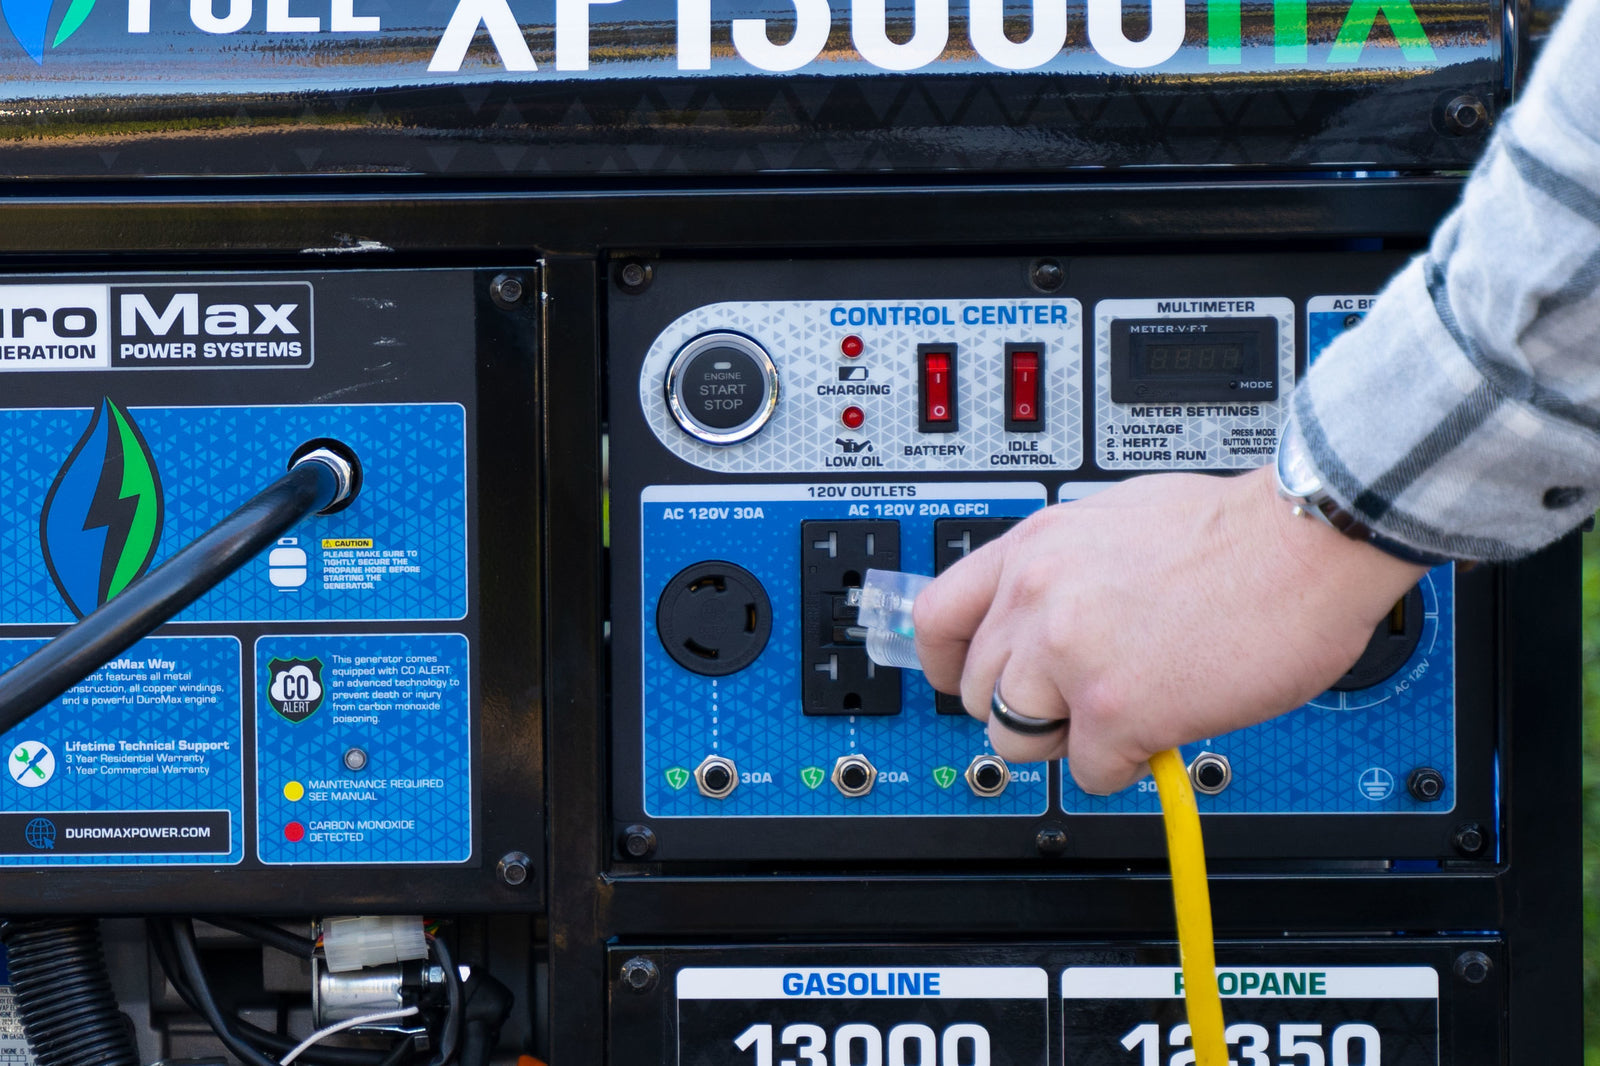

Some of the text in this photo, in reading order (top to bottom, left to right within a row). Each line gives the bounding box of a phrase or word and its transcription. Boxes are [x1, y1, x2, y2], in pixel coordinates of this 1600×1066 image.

[1157, 301, 1255, 313] MULTIMETER
[1333, 299, 1353, 309] AC
[0, 293, 300, 338] ro Max
[830, 305, 1068, 326] CONTROL CENTER
[0, 345, 96, 360] ERATION
[121, 341, 302, 359] POWER SYSTEMS
[704, 372, 742, 381] ENGINE
[700, 384, 747, 395] START
[817, 385, 890, 396] CHARGING
[704, 399, 743, 410] STOP
[1131, 406, 1260, 417] METER SETTINGS
[1107, 425, 1183, 435] 1. VOLTAGE
[1008, 441, 1038, 452] IDLE
[1107, 438, 1168, 448] 2. HERTZ
[1223, 438, 1250, 446] BUTTON
[904, 445, 966, 456] BATTERY
[1107, 451, 1206, 461] 3. HOURS RUN
[825, 456, 883, 467] LOW OIL
[990, 454, 1057, 465] CONTROL
[808, 486, 917, 497] 120V OUTLETS
[663, 508, 764, 519] AC 120V 30A
[848, 503, 989, 516] AC 120V 20A GFCI
[323, 582, 375, 590] GENERATOR.
[101, 659, 175, 671] roMax Way
[332, 655, 351, 663] This
[355, 656, 402, 665] generator
[105, 672, 147, 681] features
[150, 672, 161, 681] all
[163, 671, 191, 680] metal
[332, 667, 375, 676] equipped
[378, 667, 398, 675] with
[401, 666, 415, 674] CO
[1395, 658, 1430, 695] AC 120V
[283, 675, 309, 700] CO
[347, 678, 392, 686] advanced
[394, 678, 447, 688] technology
[130, 684, 140, 693] all
[143, 685, 177, 695] copper
[179, 683, 224, 694] windings,
[62, 696, 80, 704] and
[91, 695, 133, 706] powerful
[137, 695, 182, 704] DuroMax
[333, 691, 369, 700] prevent
[372, 690, 399, 698] death
[415, 690, 441, 700] injury
[282, 702, 310, 713] ALERT
[332, 702, 440, 710] from carbon monoxide
[333, 714, 380, 724] poisoning.
[65, 740, 229, 752] Lifetime Technical Support
[66, 754, 204, 764] 3 Year Residential Warranty
[66, 765, 209, 775] 1 Year Commercial Warranty
[741, 772, 773, 784] 30A
[878, 772, 909, 783] 20A
[1010, 771, 1041, 782] 20A
[308, 779, 444, 789] MAINTENANCE REQUIRED
[1138, 781, 1158, 792] 30
[308, 792, 378, 801] SEE MANUAL
[309, 820, 415, 830] CARBON MONOXIDE
[65, 827, 210, 839] DUROMAXPOWER.COM
[309, 833, 363, 842] DETECTED
[782, 972, 941, 996] GASOLINE
[1174, 972, 1326, 995] POPANE
[734, 1024, 990, 1066] 13000
